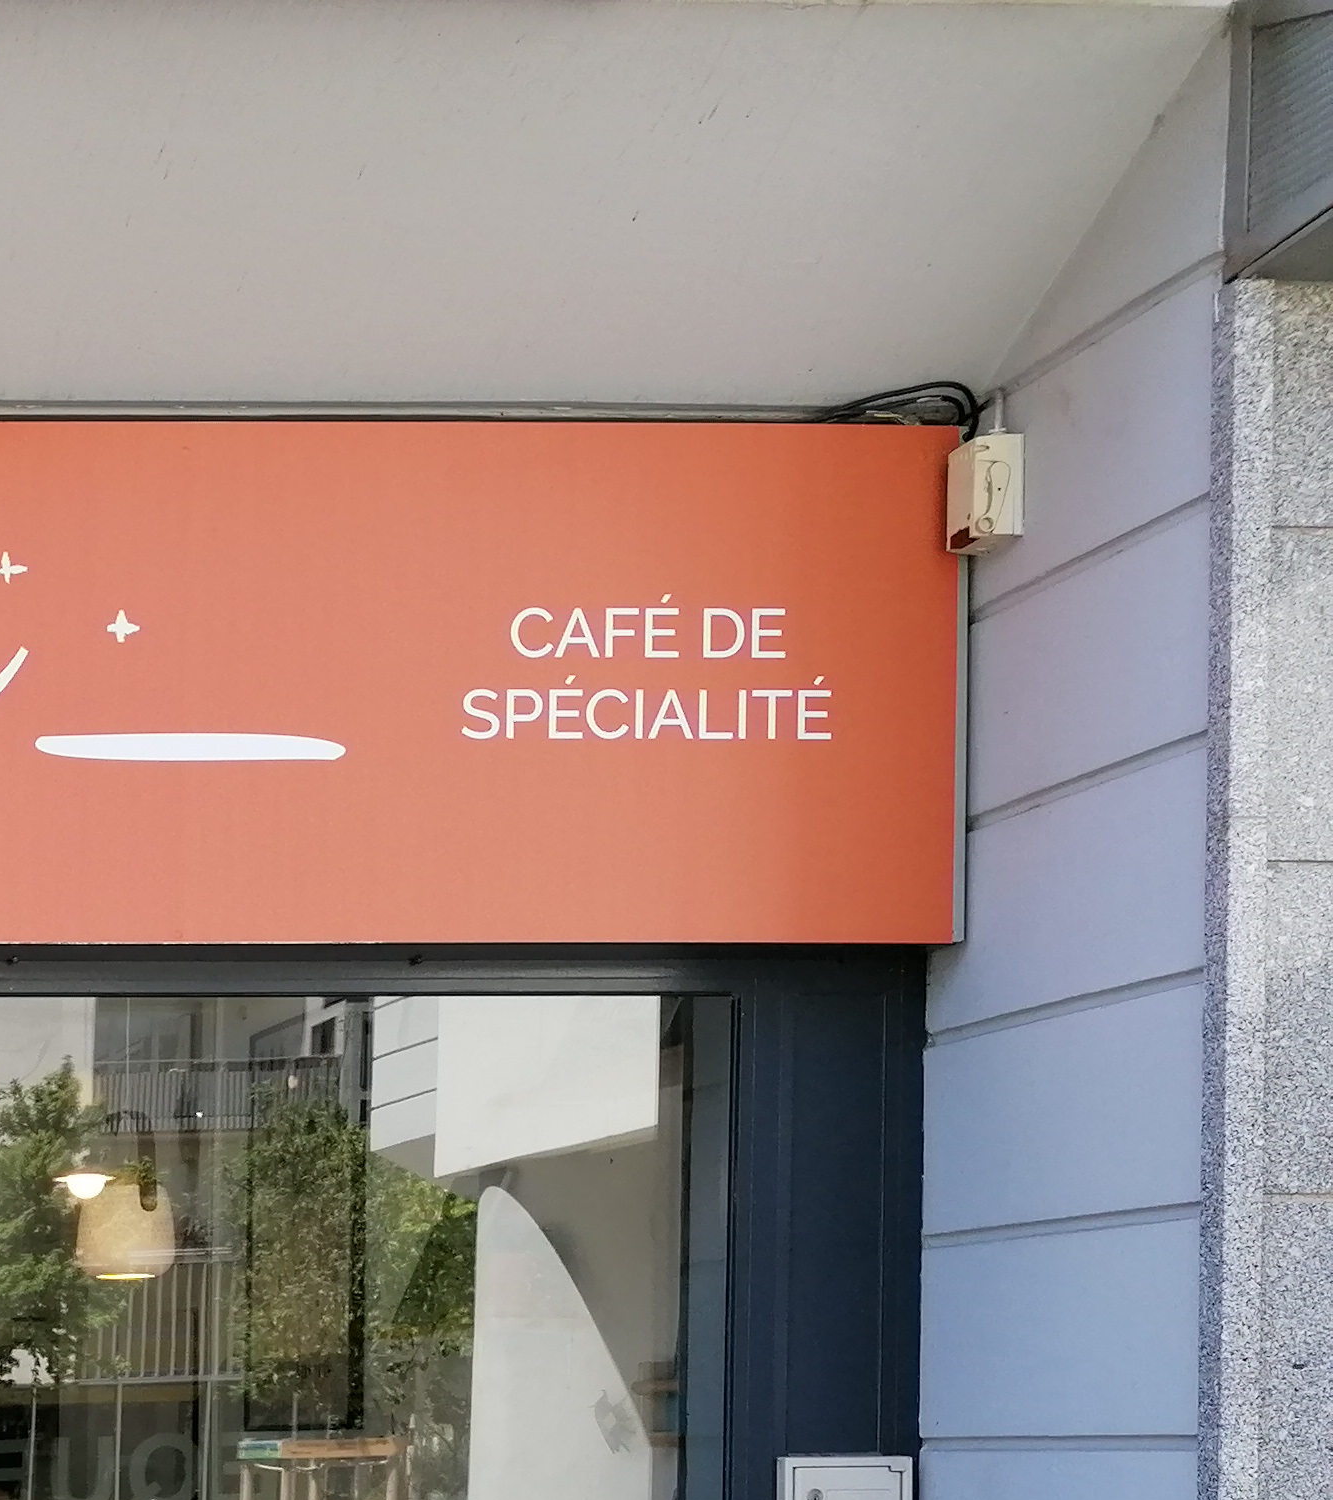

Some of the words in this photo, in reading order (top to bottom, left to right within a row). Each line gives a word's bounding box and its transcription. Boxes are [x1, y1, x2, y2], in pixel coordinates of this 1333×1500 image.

[509, 593, 681, 660] CAFÉ
[701, 606, 788, 660] DE
[460, 674, 833, 741] SPÉCIALITÉ
